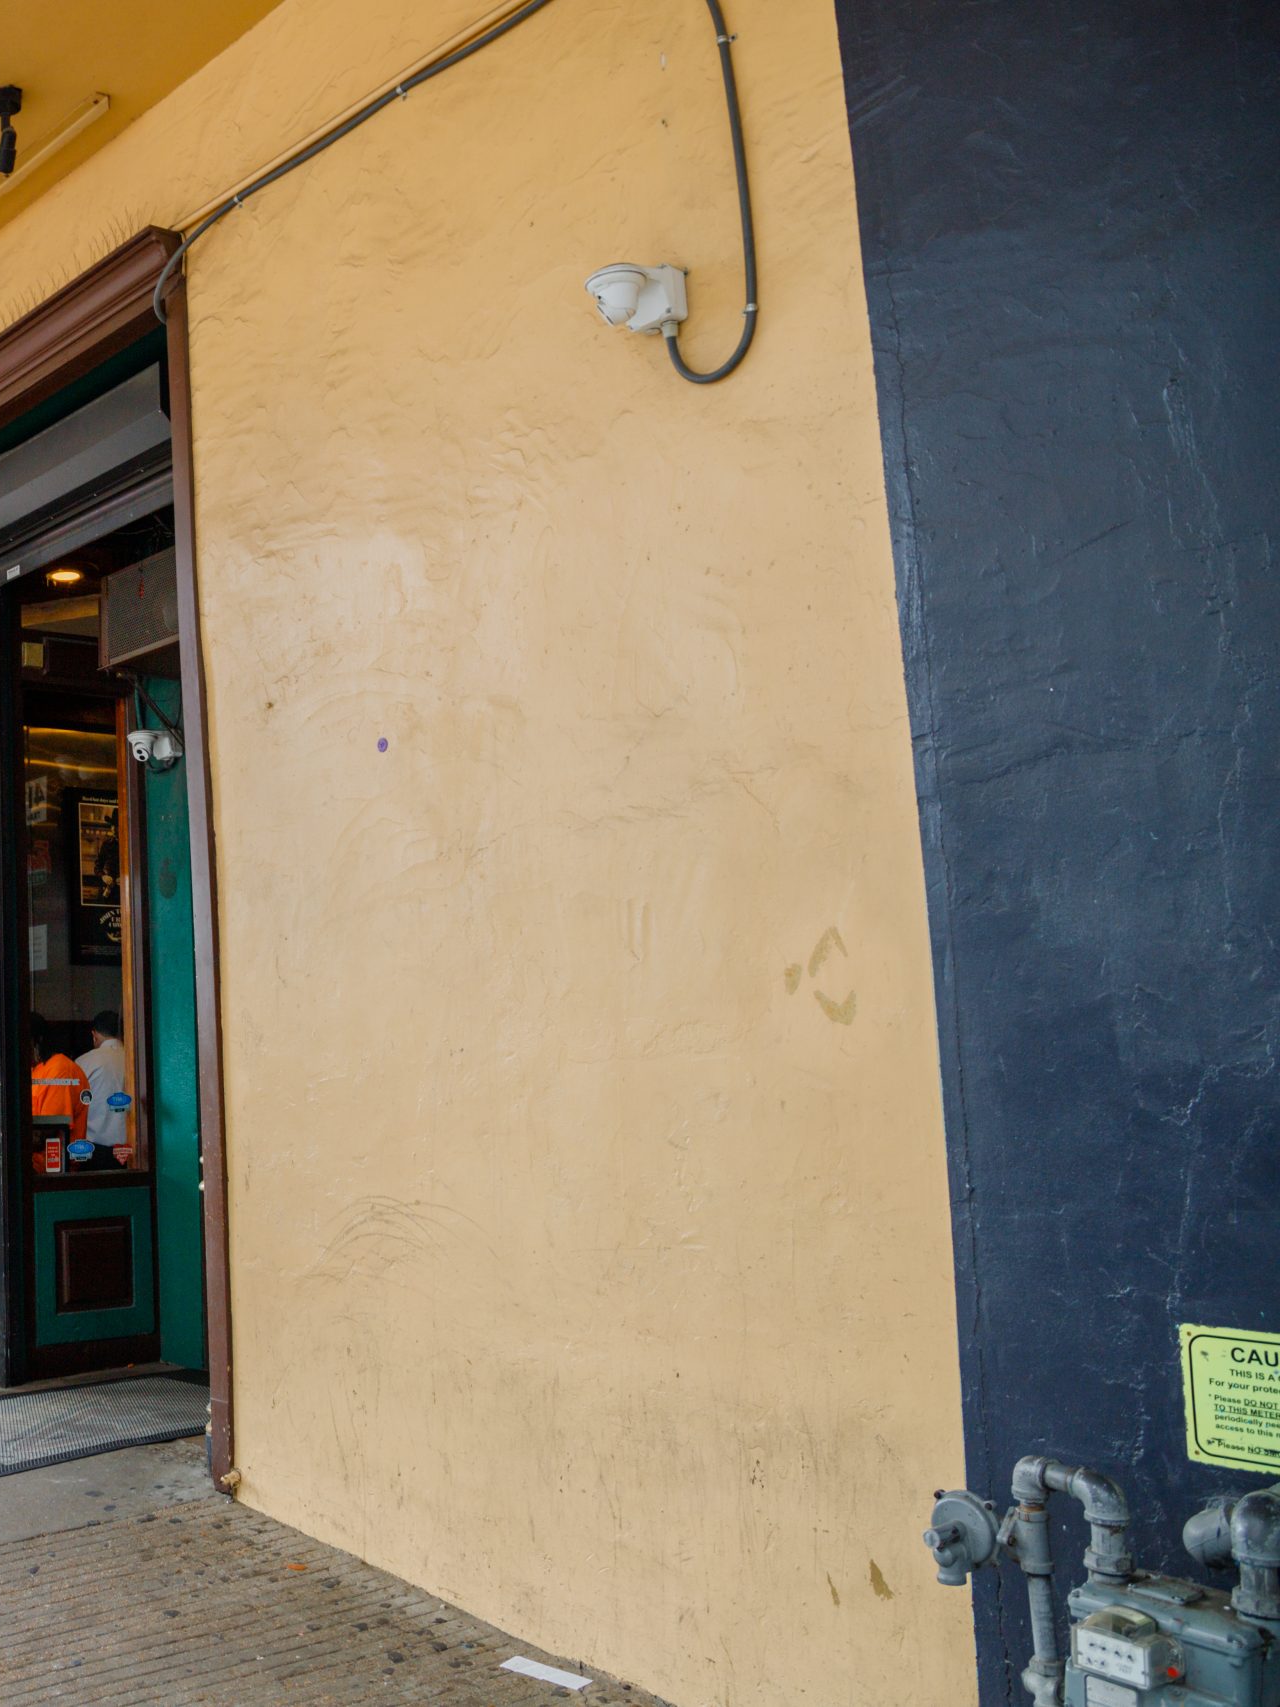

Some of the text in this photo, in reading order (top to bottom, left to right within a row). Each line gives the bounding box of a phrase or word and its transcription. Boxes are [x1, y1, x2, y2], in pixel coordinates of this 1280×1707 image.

[1229, 1369, 1252, 1379] THIS
[1255, 1372, 1265, 1380] IS
[1268, 1374, 1275, 1382] A
[1209, 1377, 1224, 1387] For
[1227, 1382, 1250, 1390] your
[1214, 1393, 1278, 1410] Please DO NOT
[1214, 1403, 1225, 1412] TO
[1228, 1405, 1247, 1415] THIS
[1214, 1414, 1263, 1428] periodically
[1215, 1423, 1244, 1433] access
[1257, 1428, 1273, 1437] this
[1218, 1440, 1245, 1452] Please
[1248, 1446, 1261, 1455] NO
